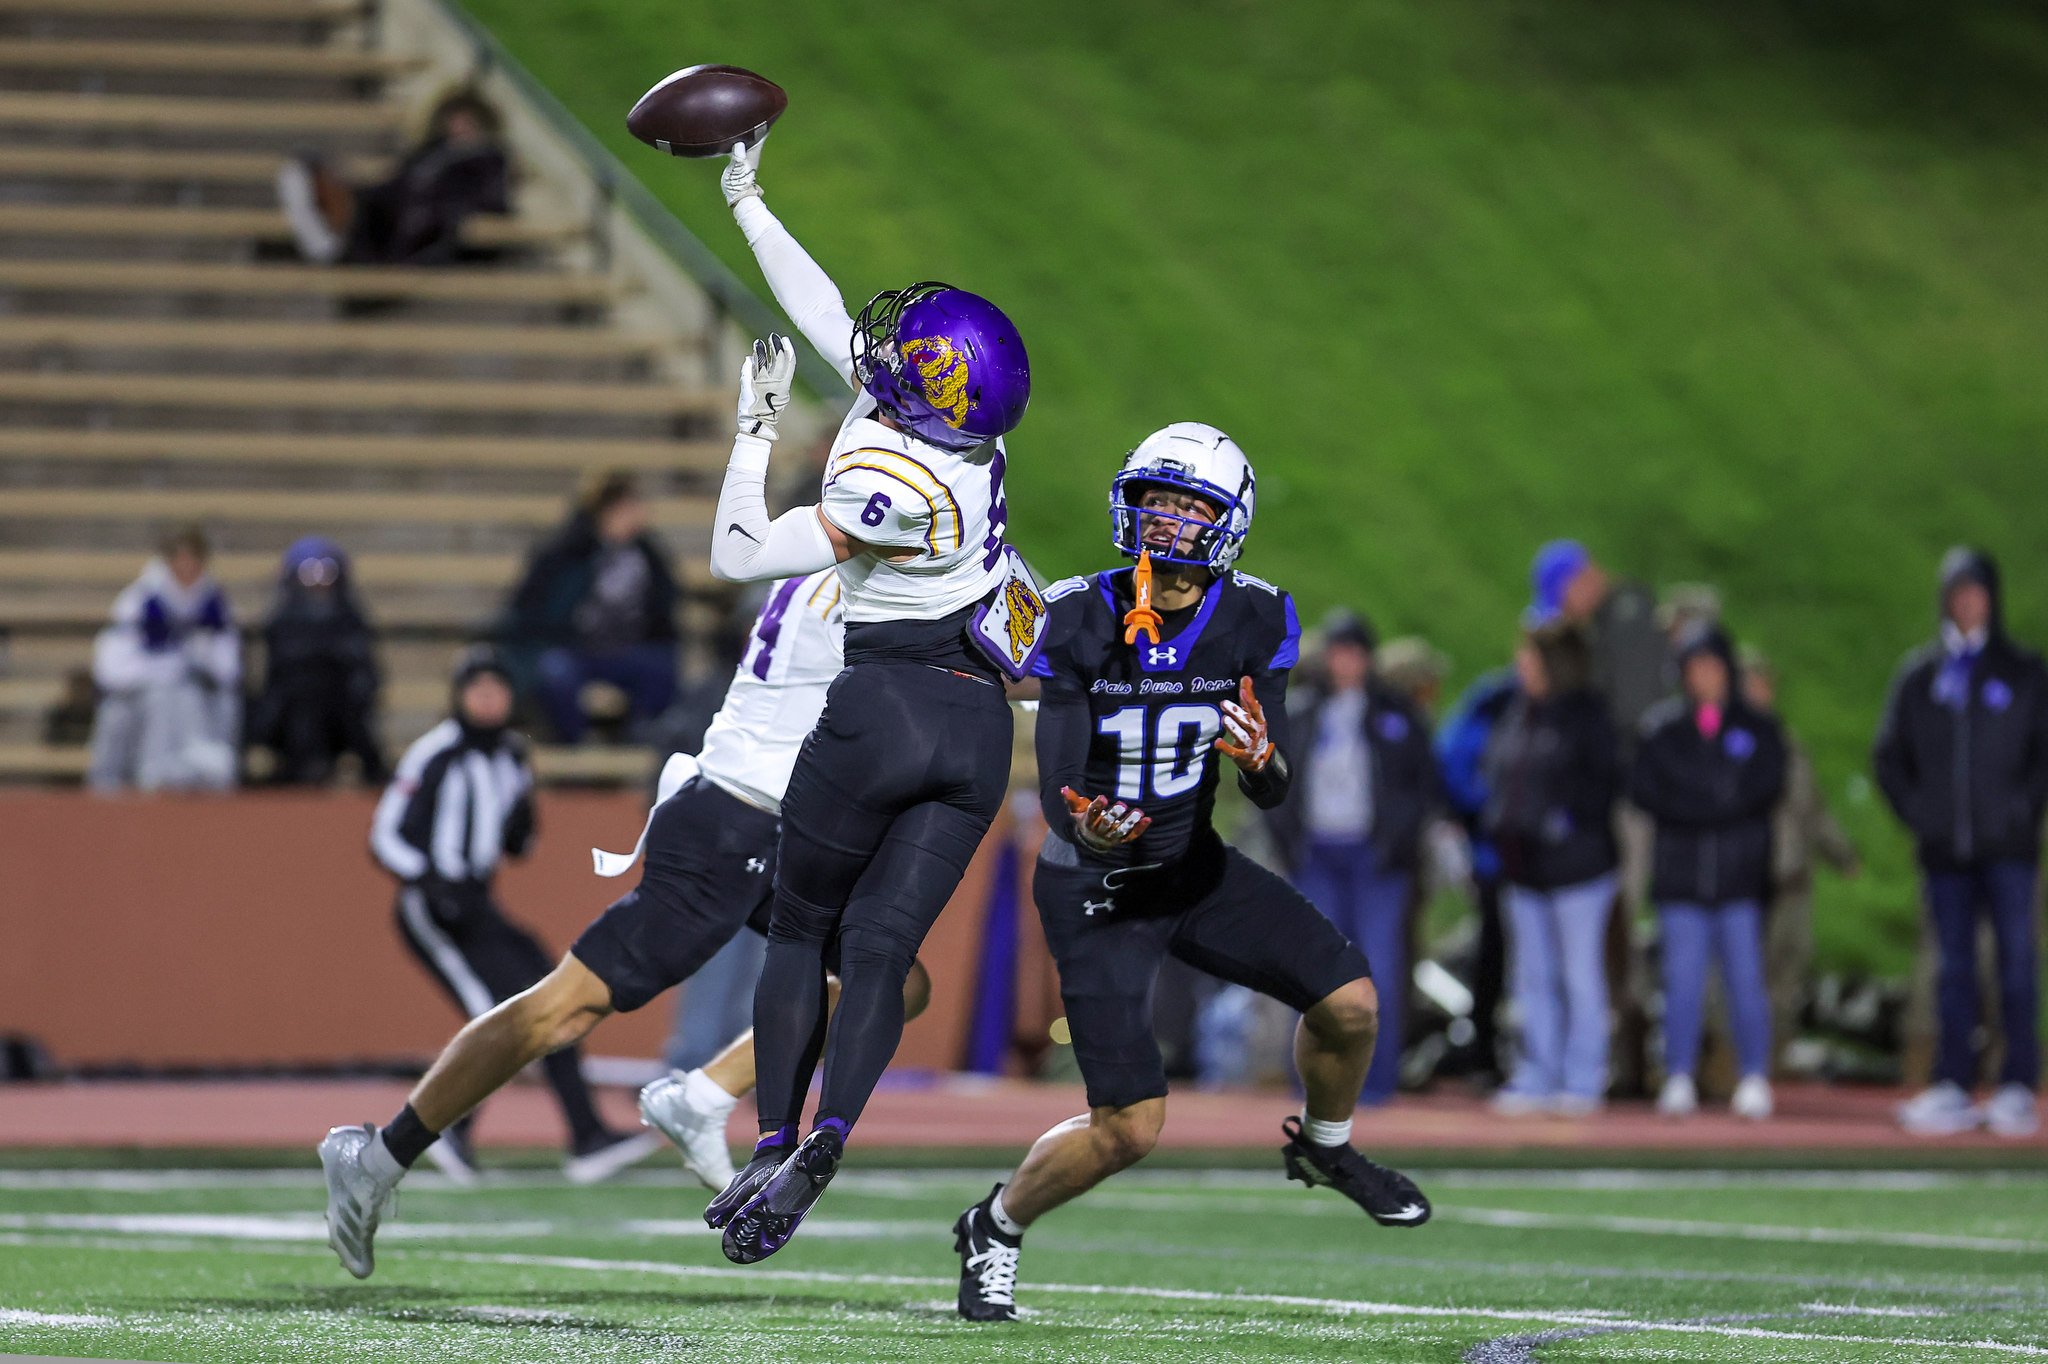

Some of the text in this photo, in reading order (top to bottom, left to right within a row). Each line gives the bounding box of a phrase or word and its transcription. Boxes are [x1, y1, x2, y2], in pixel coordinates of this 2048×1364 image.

[860, 491, 892, 528] 6
[1090, 676, 1236, 694] Palo Duro Dons
[1097, 703, 1223, 801] 10
